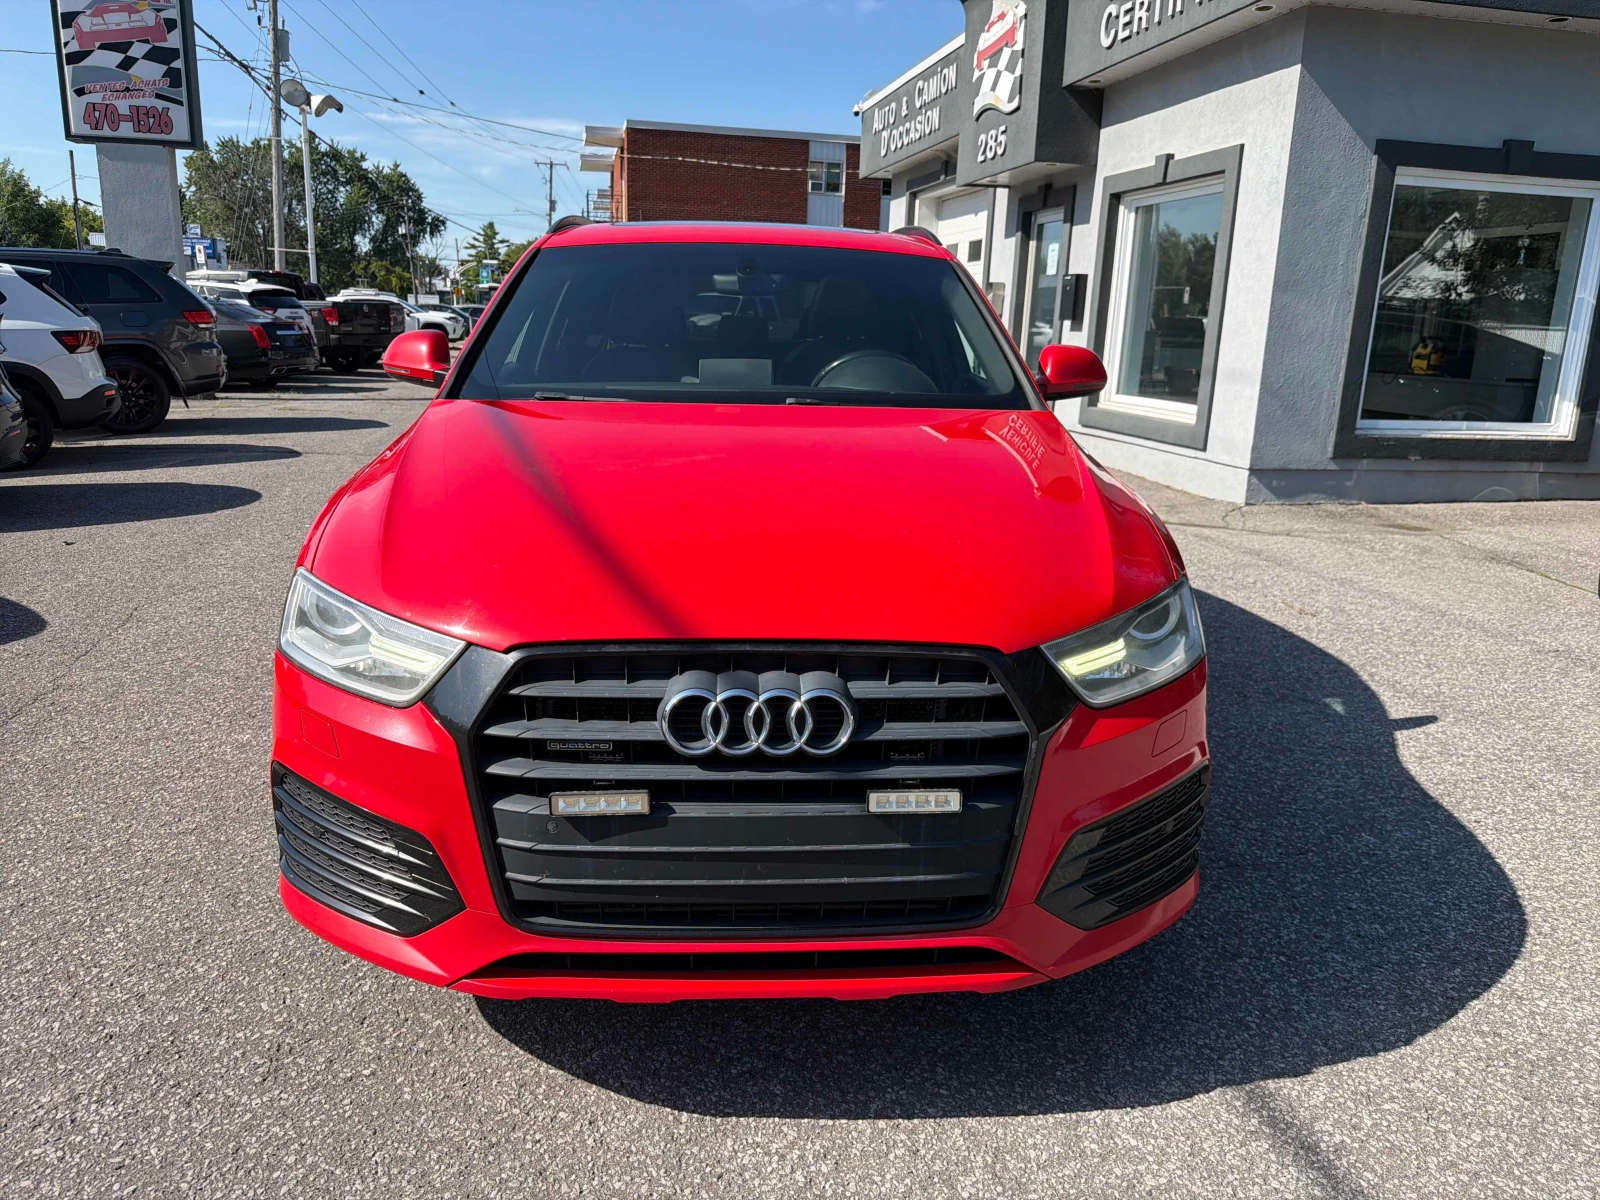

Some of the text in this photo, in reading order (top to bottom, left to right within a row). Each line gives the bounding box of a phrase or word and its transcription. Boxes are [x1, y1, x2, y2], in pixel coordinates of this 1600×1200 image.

[85, 78, 170, 93] VENTES ACHATS
[83, 102, 174, 135] 470-1526
[901, 96, 909, 118] &
[977, 125, 1008, 163] 285
